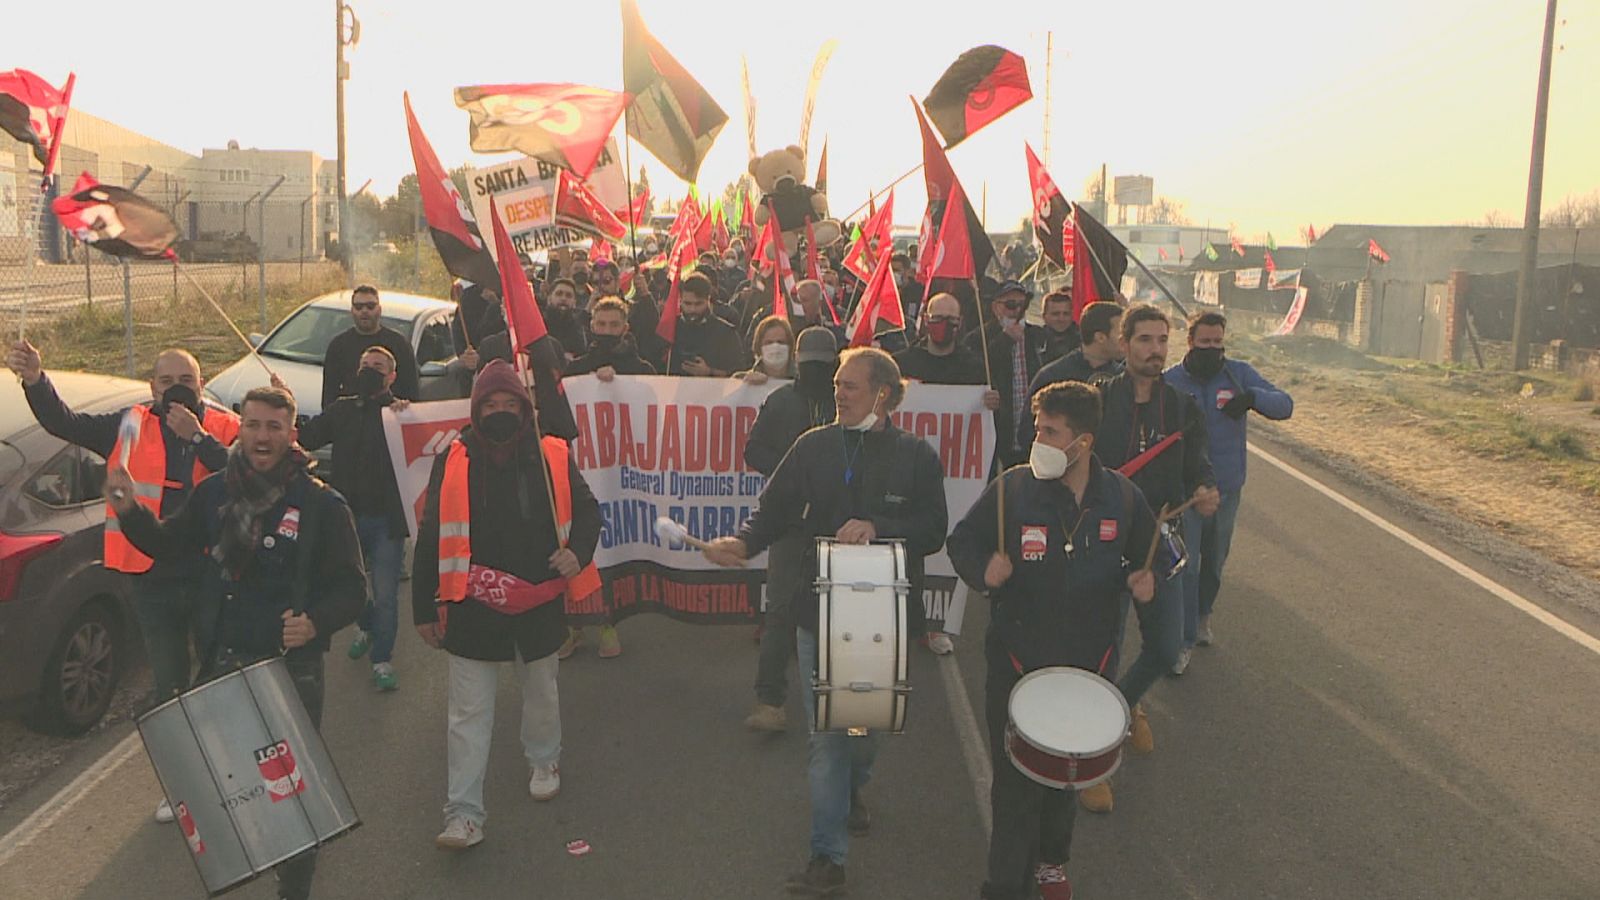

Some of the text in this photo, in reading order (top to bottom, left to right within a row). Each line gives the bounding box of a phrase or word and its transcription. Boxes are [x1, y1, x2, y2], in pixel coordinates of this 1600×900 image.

[474, 166, 529, 196] SANTA
[620, 466, 665, 495] General
[670, 471, 733, 500] Dynamics
[601, 500, 661, 549] SANTA
[1023, 551, 1045, 561] CGT
[641, 573, 660, 603] LA
[258, 741, 288, 764] CGT
